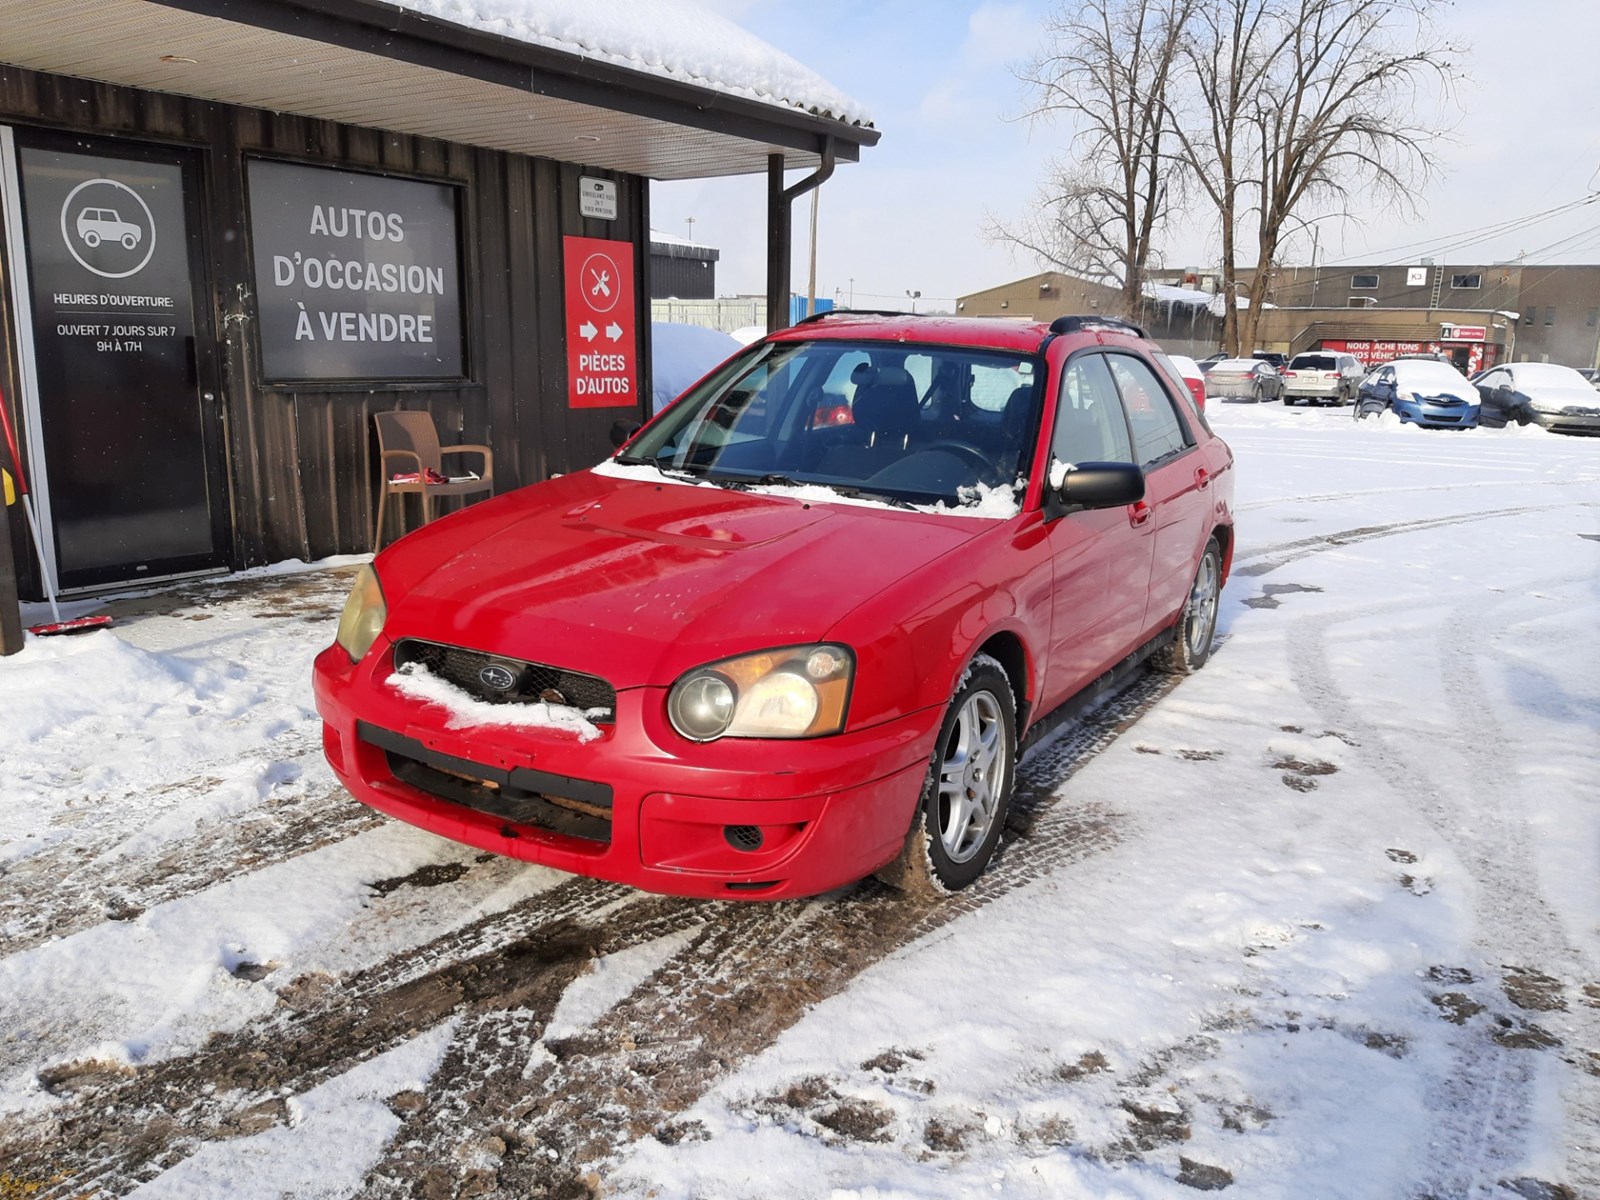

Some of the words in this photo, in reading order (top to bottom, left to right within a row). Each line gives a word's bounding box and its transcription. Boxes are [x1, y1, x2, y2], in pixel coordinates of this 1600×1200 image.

[309, 205, 404, 242] AUTOS
[53, 293, 99, 306] HEURES
[57, 324, 101, 336] OUVERT
[102, 325, 110, 336] 7
[111, 325, 146, 337] JOURS
[147, 326, 169, 337] SUR
[170, 326, 176, 337] 7
[295, 301, 315, 341] À
[318, 311, 433, 343] VENDRE
[96, 341, 113, 352] 9H
[114, 338, 123, 352] À
[123, 341, 143, 352] 17H
[1346, 342, 1370, 350] NOUS
[579, 349, 626, 372] PIÈCES
[576, 375, 630, 395] D'AUTOS
